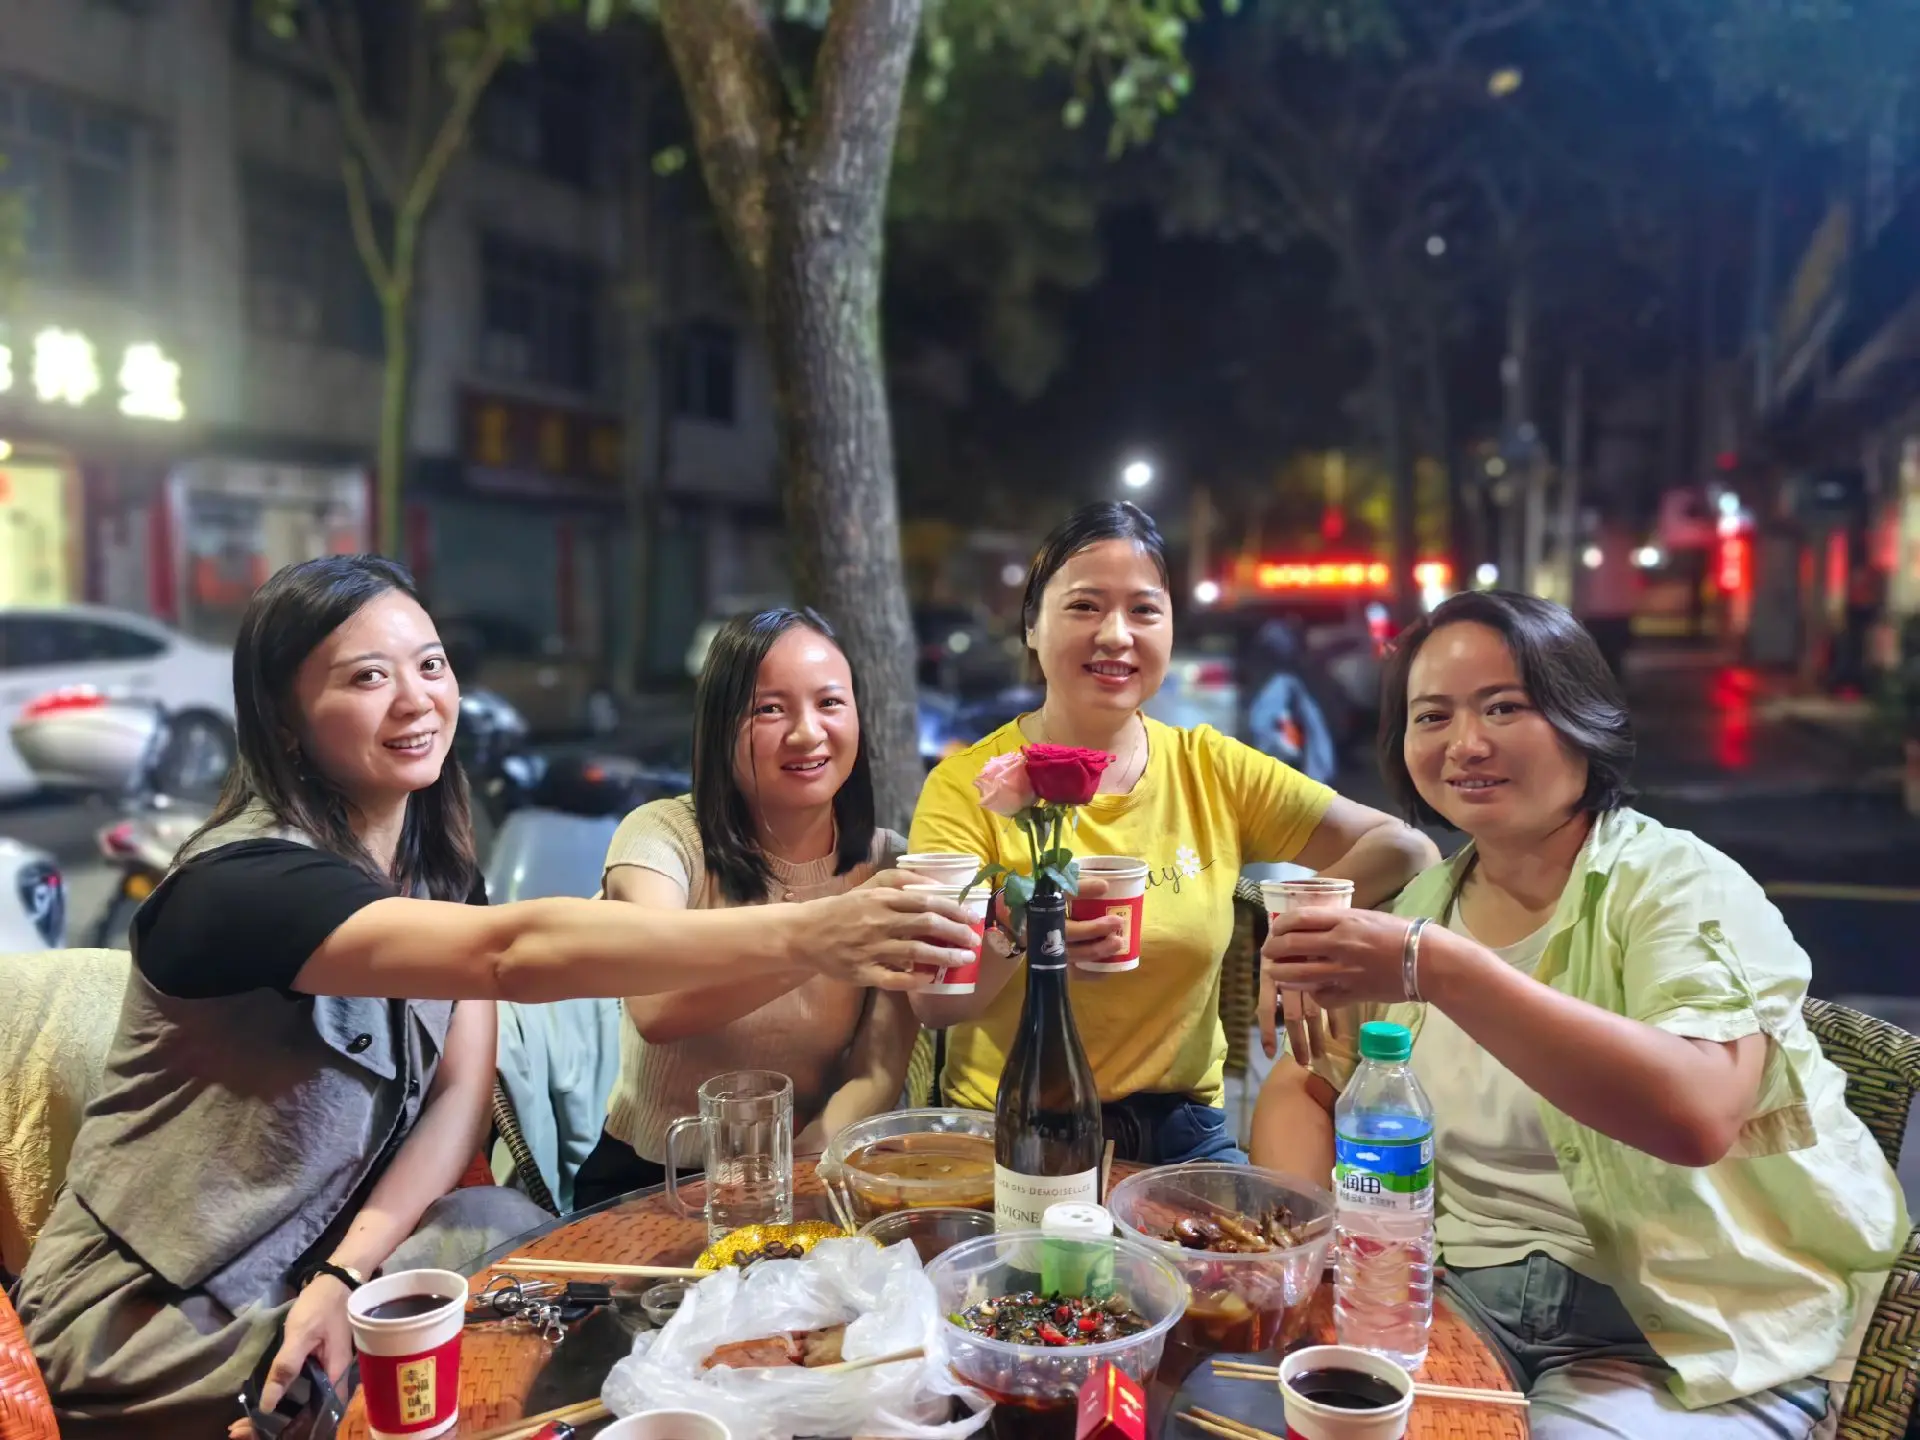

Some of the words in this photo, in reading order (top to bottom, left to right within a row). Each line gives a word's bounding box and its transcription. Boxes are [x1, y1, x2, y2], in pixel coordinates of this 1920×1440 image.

[1029, 1183, 1091, 1197] DEMOISELLES
[1343, 1173, 1381, 1194] 润田
[1001, 1204, 1041, 1224] VIGNE
